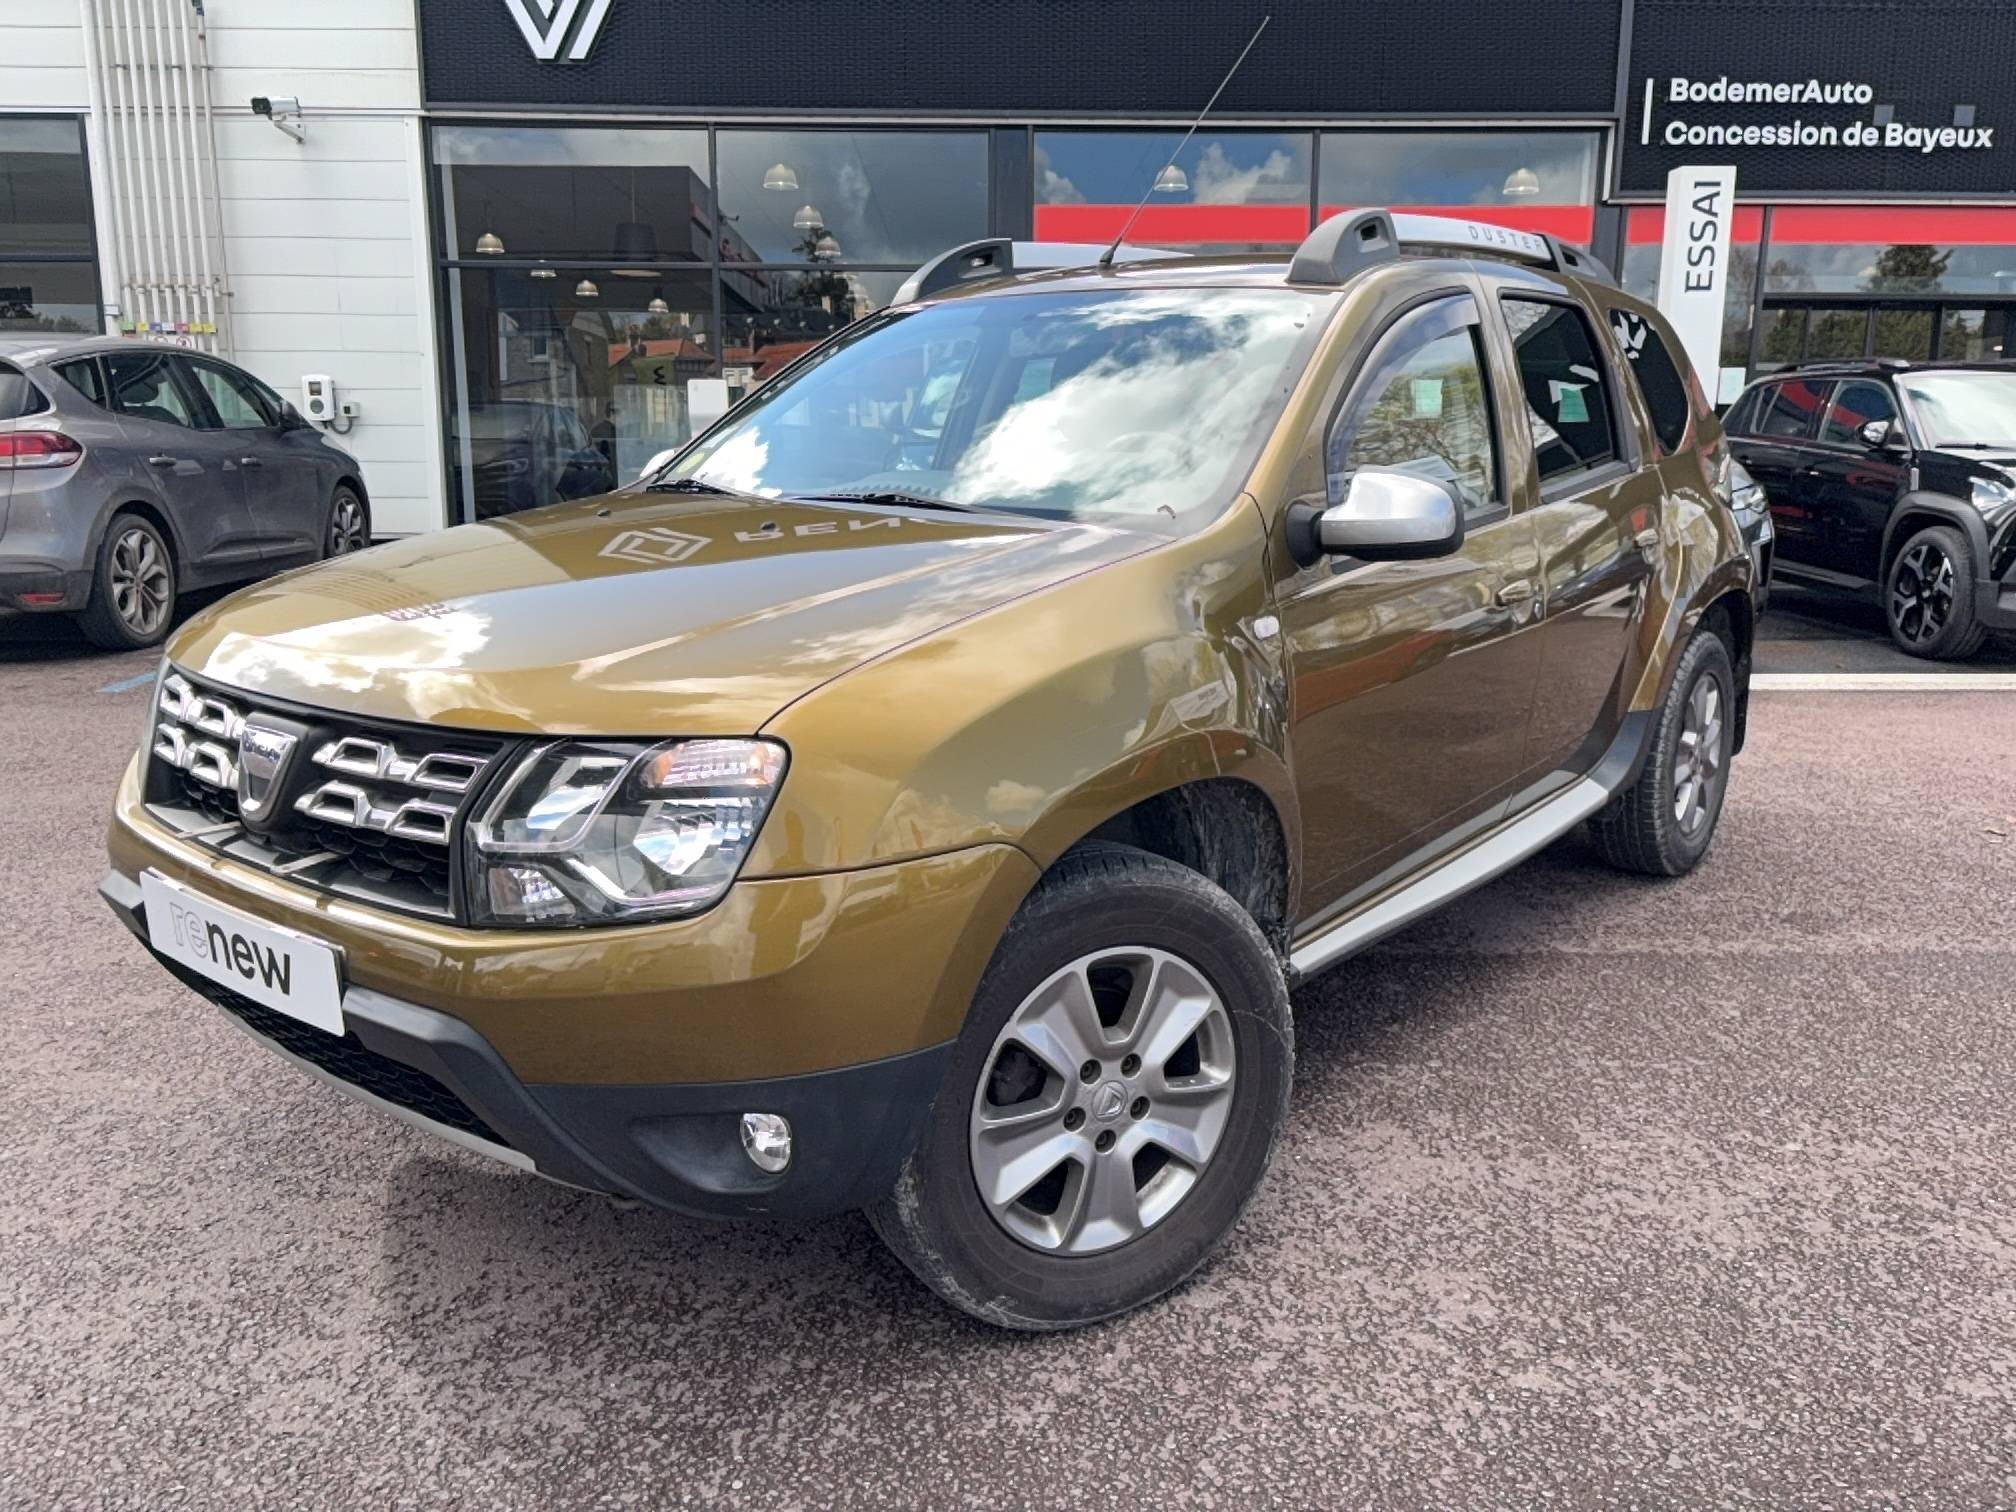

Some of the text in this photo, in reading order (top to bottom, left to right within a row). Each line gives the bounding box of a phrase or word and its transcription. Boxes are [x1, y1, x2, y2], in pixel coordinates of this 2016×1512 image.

[1670, 76, 1873, 104] BodemerAuto
[1665, 120, 1994, 153] Concession de Bayeux
[1684, 180, 1722, 293] ESSAI
[169, 901, 291, 996] renew
